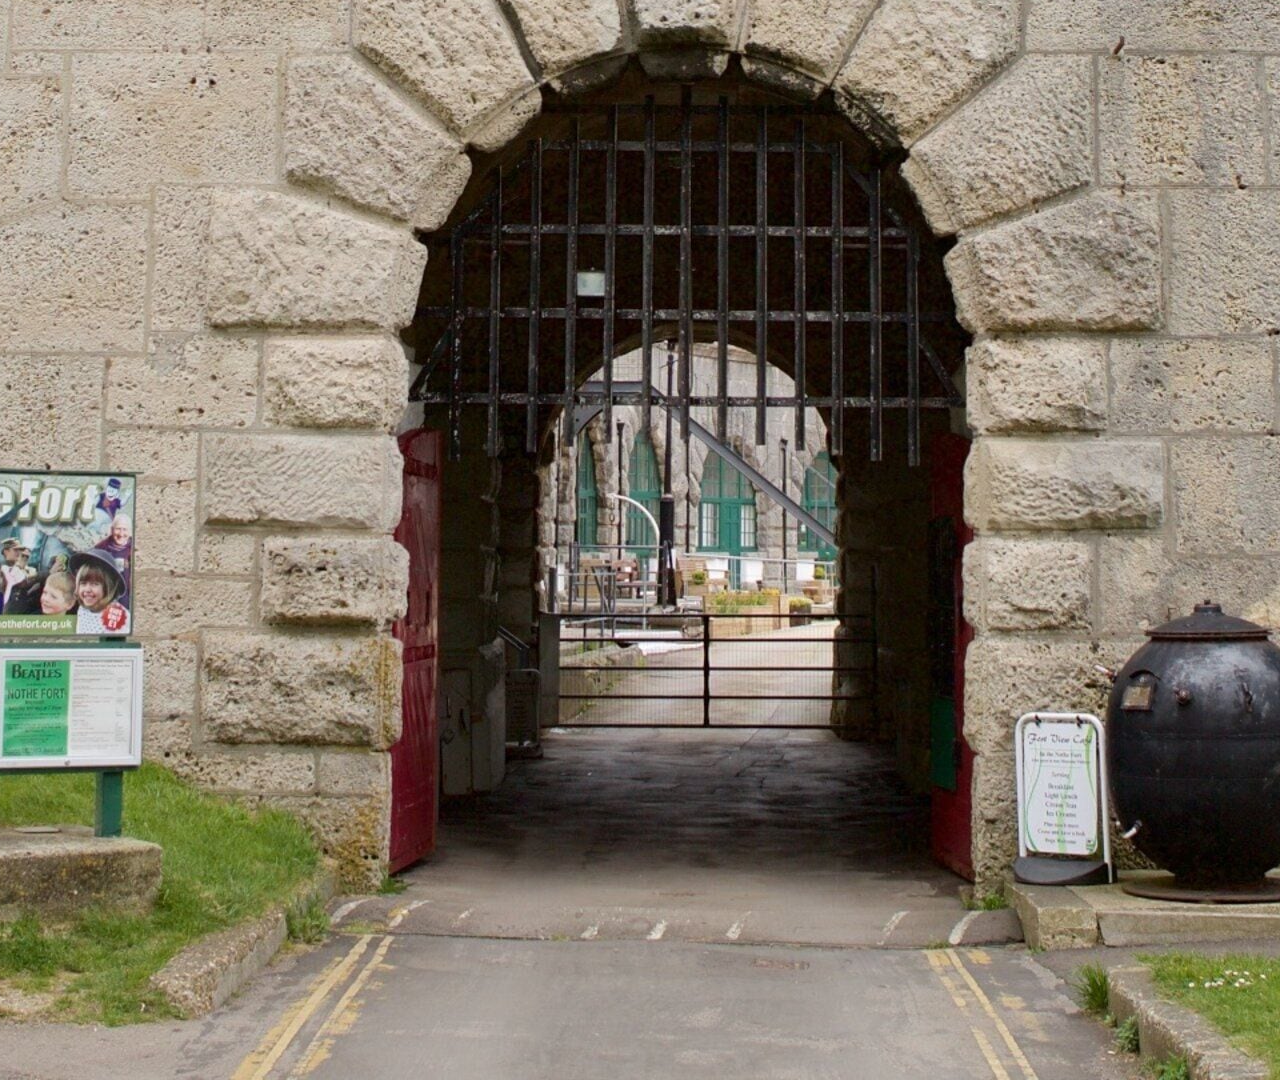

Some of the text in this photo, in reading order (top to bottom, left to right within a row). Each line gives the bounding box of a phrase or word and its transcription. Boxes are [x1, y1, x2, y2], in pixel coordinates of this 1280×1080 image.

[21, 480, 96, 520] Fort
[8, 688, 65, 699] NOTHE FORT
